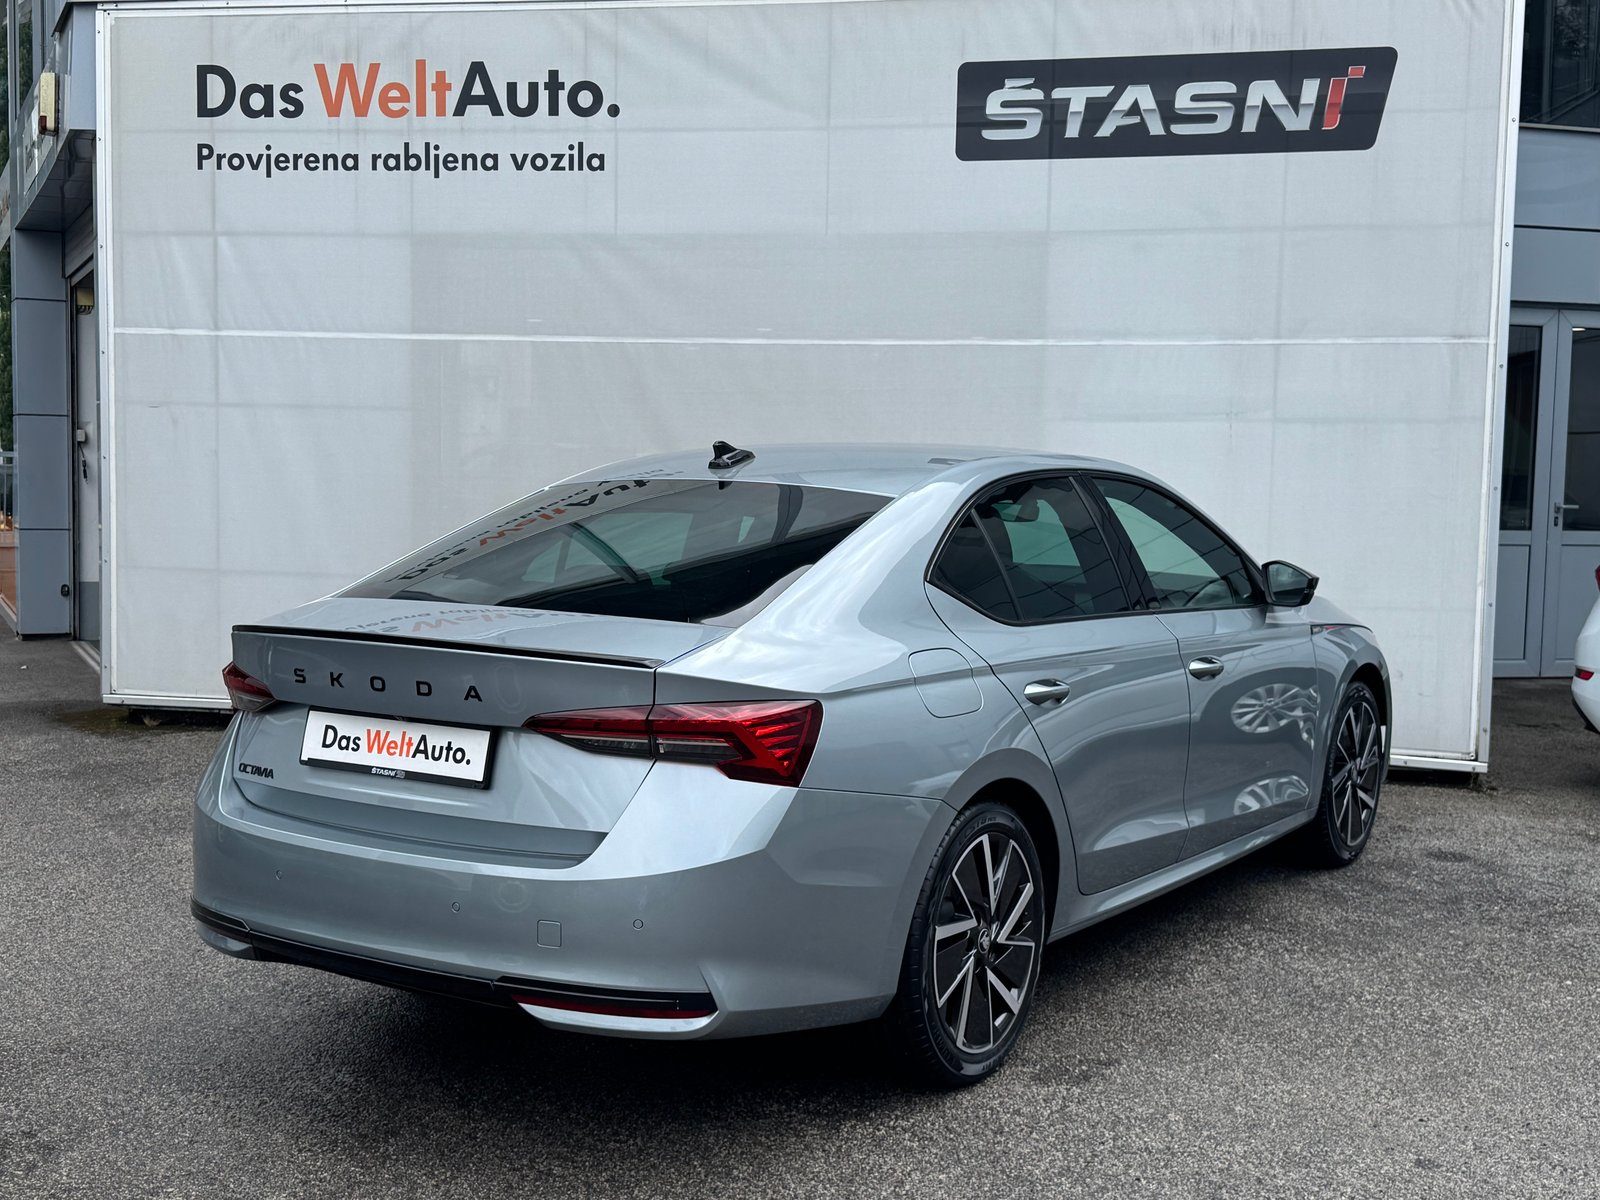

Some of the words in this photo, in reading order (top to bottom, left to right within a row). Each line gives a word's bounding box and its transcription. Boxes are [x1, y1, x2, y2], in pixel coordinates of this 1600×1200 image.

[196, 64, 304, 119] Das
[313, 58, 621, 119] WeltAuto.
[196, 143, 360, 178] Provjerena
[371, 141, 499, 178] rabljena
[510, 141, 606, 171] vozila
[321, 724, 362, 752] Das
[365, 728, 472, 766] WeltAuto.
[238, 762, 275, 780] OCTAVIA
